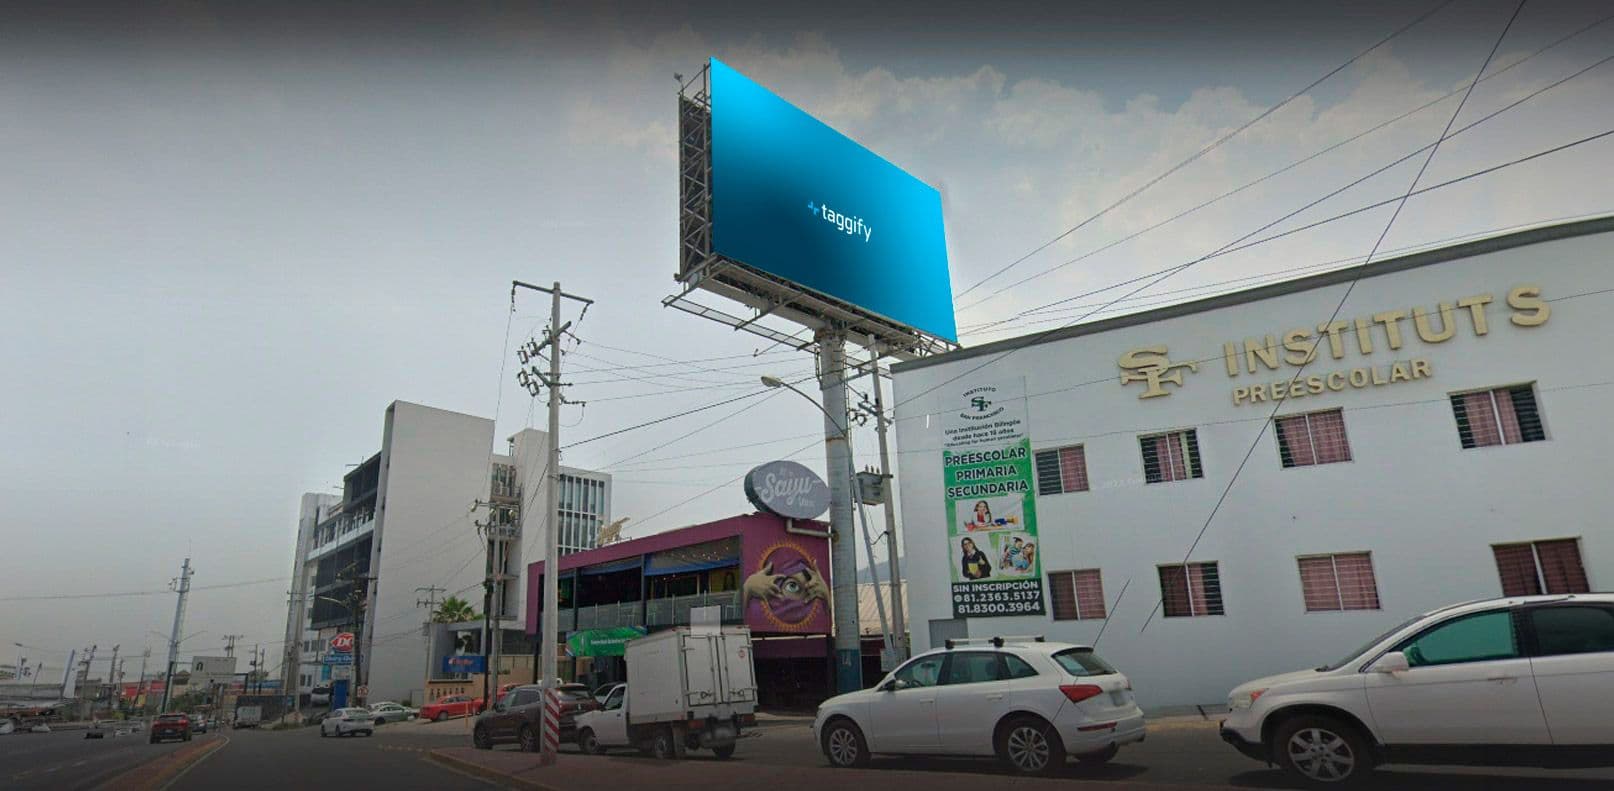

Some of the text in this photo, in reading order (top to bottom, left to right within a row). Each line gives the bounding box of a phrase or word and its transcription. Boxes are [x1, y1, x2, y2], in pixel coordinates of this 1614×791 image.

[821, 203, 872, 242] taggify
[1223, 286, 1551, 377] INSTITUTS
[1232, 357, 1433, 406] PREESCOLAR
[945, 447, 1026, 466] PREESCOLAR
[956, 465, 1017, 480] PRIMARIA
[948, 480, 1029, 498] SECUNDARIA
[953, 580, 1039, 592] SIN INSCRIPCIÓN
[963, 591, 1040, 602] 81.2363.5137
[958, 602, 1040, 614] 81.8300.3964
